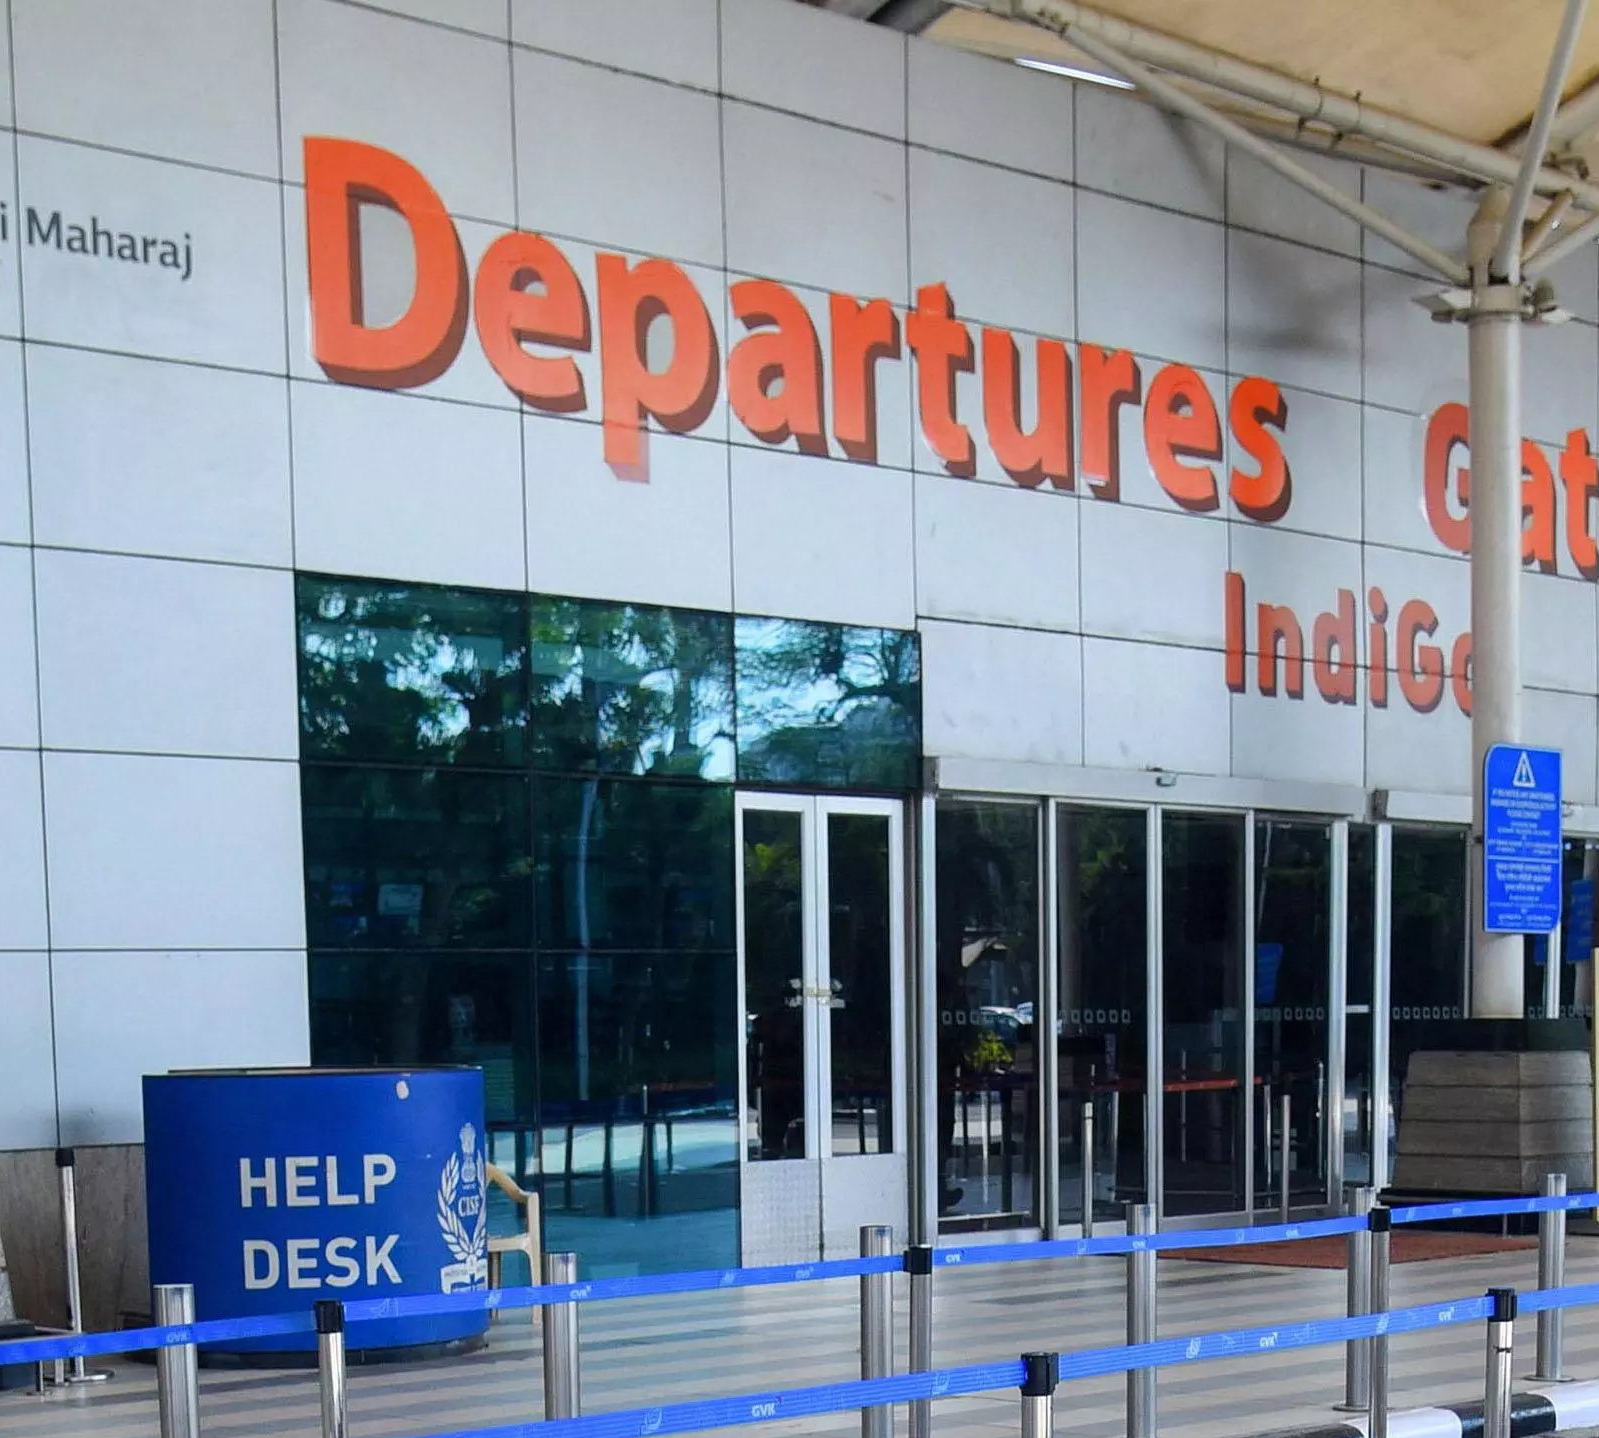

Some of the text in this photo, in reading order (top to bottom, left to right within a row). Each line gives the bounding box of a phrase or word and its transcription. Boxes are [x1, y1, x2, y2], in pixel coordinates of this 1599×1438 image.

[26, 206, 194, 282] Maharaj
[301, 134, 1293, 483] Departures
[239, 1153, 397, 1208] HELP
[242, 1234, 403, 1290] DESK
[751, 1401, 775, 1418] GVK
